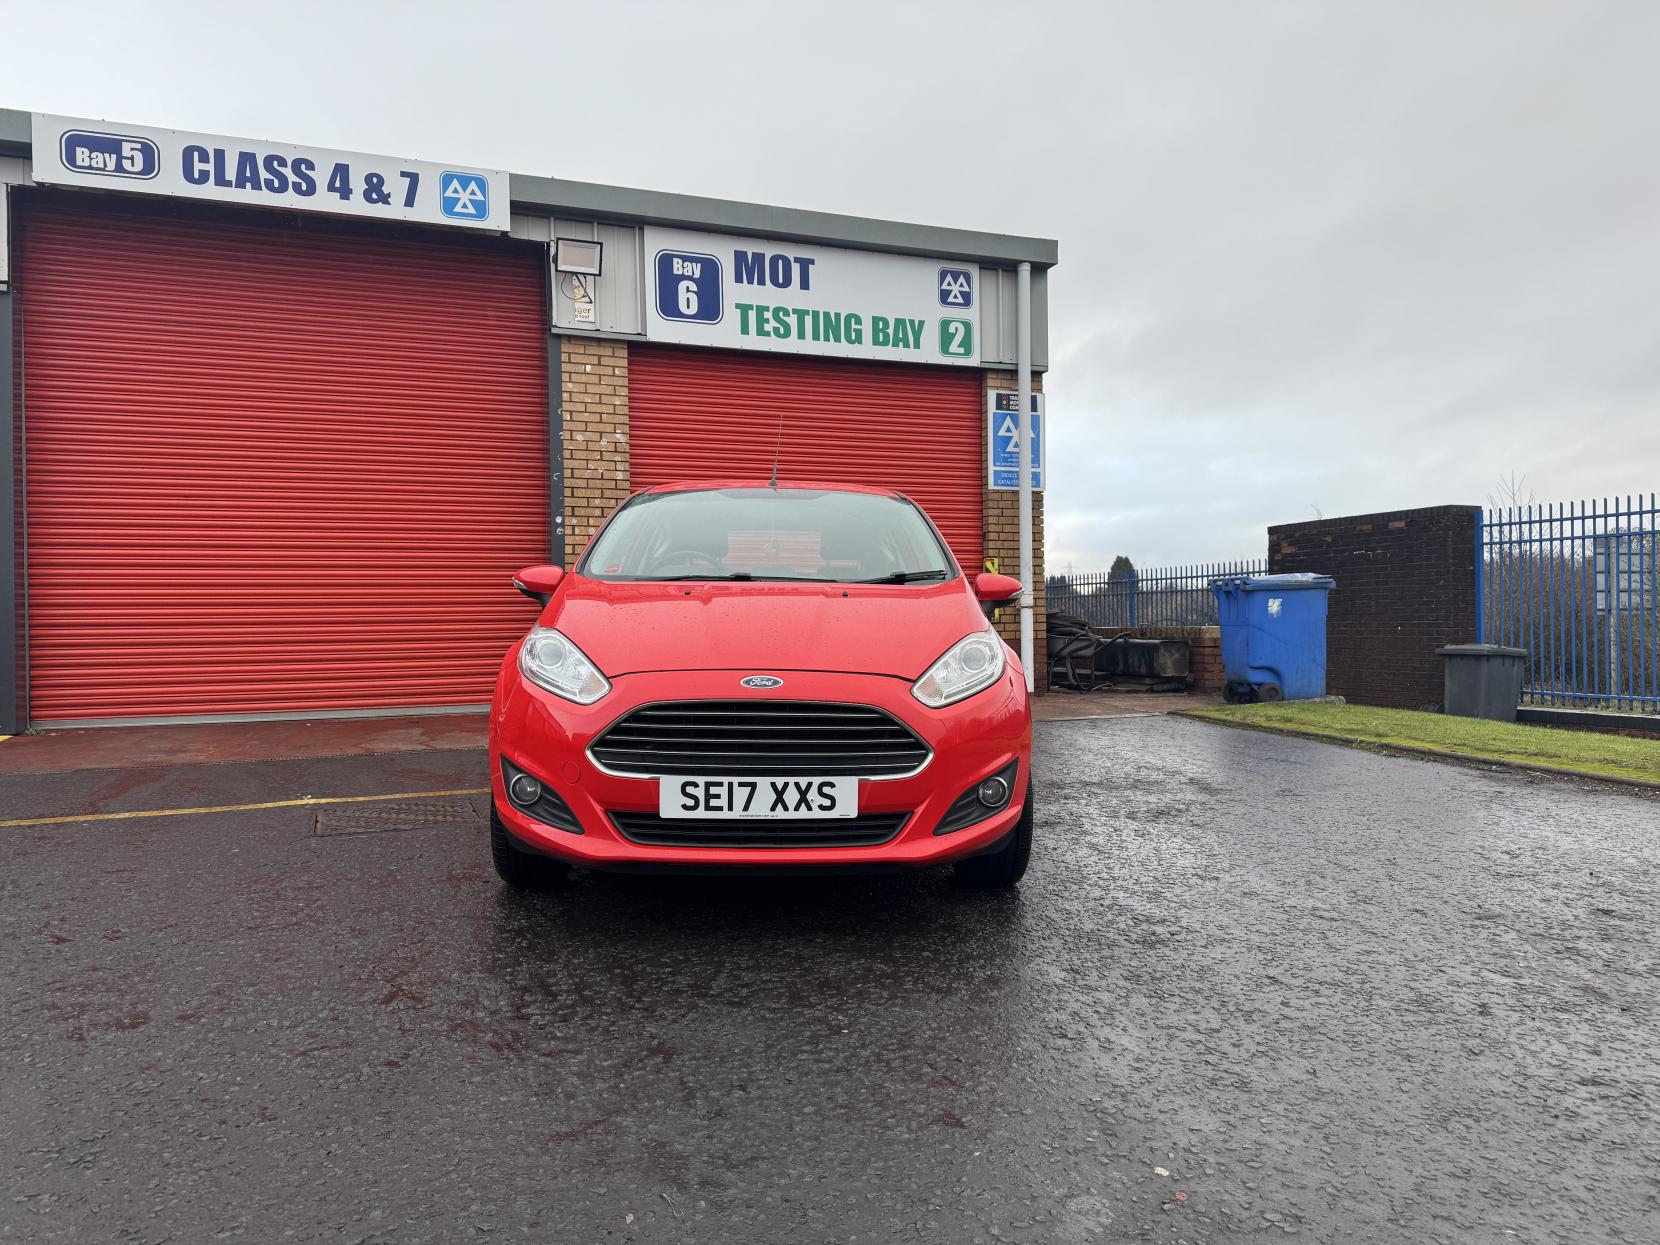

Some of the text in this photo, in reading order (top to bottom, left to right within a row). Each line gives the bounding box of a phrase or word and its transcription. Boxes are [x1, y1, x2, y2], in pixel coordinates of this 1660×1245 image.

[75, 141, 144, 173] Bay 5
[182, 144, 420, 208] CLASS 4 & 7
[672, 257, 701, 278] Bay
[733, 249, 816, 291] MOT
[574, 307, 591, 315] ger
[677, 280, 699, 316] 6
[734, 302, 965, 354] TESTING BAY 2
[750, 677, 774, 686] Ford
[680, 780, 837, 812] SE17 XXS
